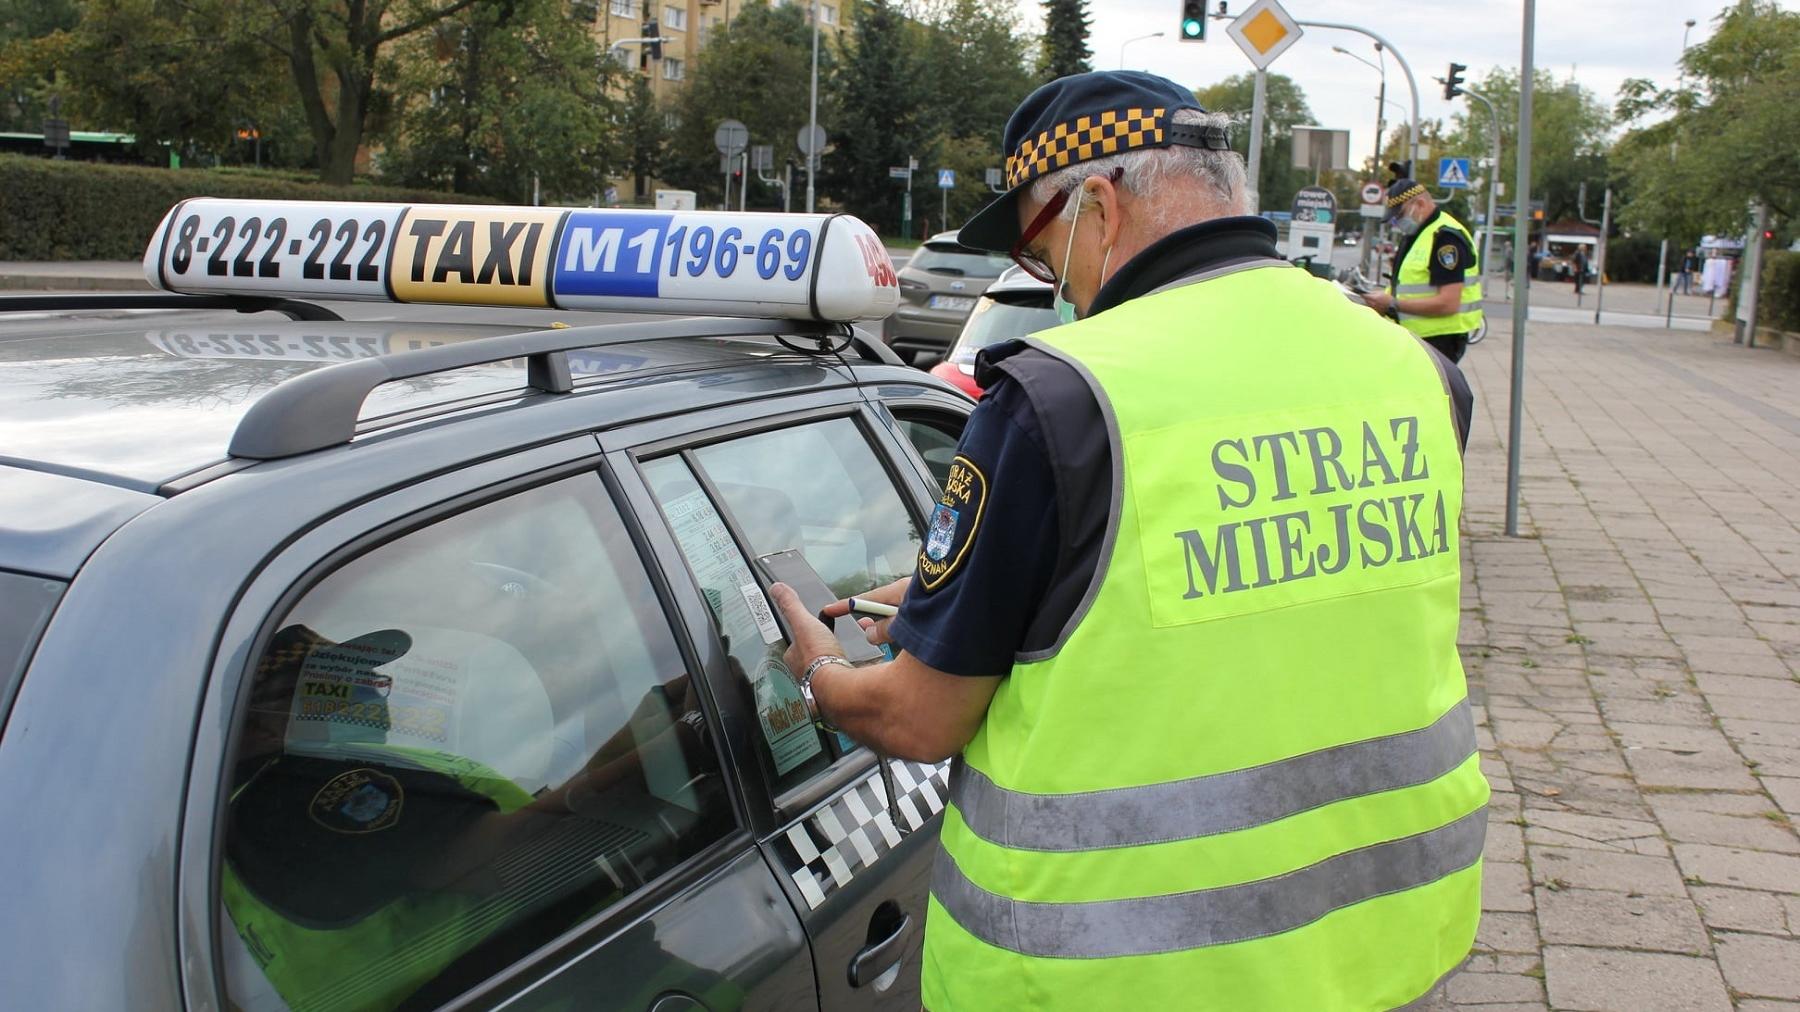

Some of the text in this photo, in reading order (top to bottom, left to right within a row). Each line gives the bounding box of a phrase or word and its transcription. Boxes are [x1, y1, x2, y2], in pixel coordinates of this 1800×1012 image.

[171, 213, 385, 282] 8-222-222
[408, 219, 545, 287] TAXI
[666, 225, 812, 282] 196-69
[949, 464, 974, 487] RAŻ
[1211, 416, 1429, 511] STRAŻ
[1174, 489, 1450, 600] MIEJSKA
[304, 682, 349, 698] TAXI
